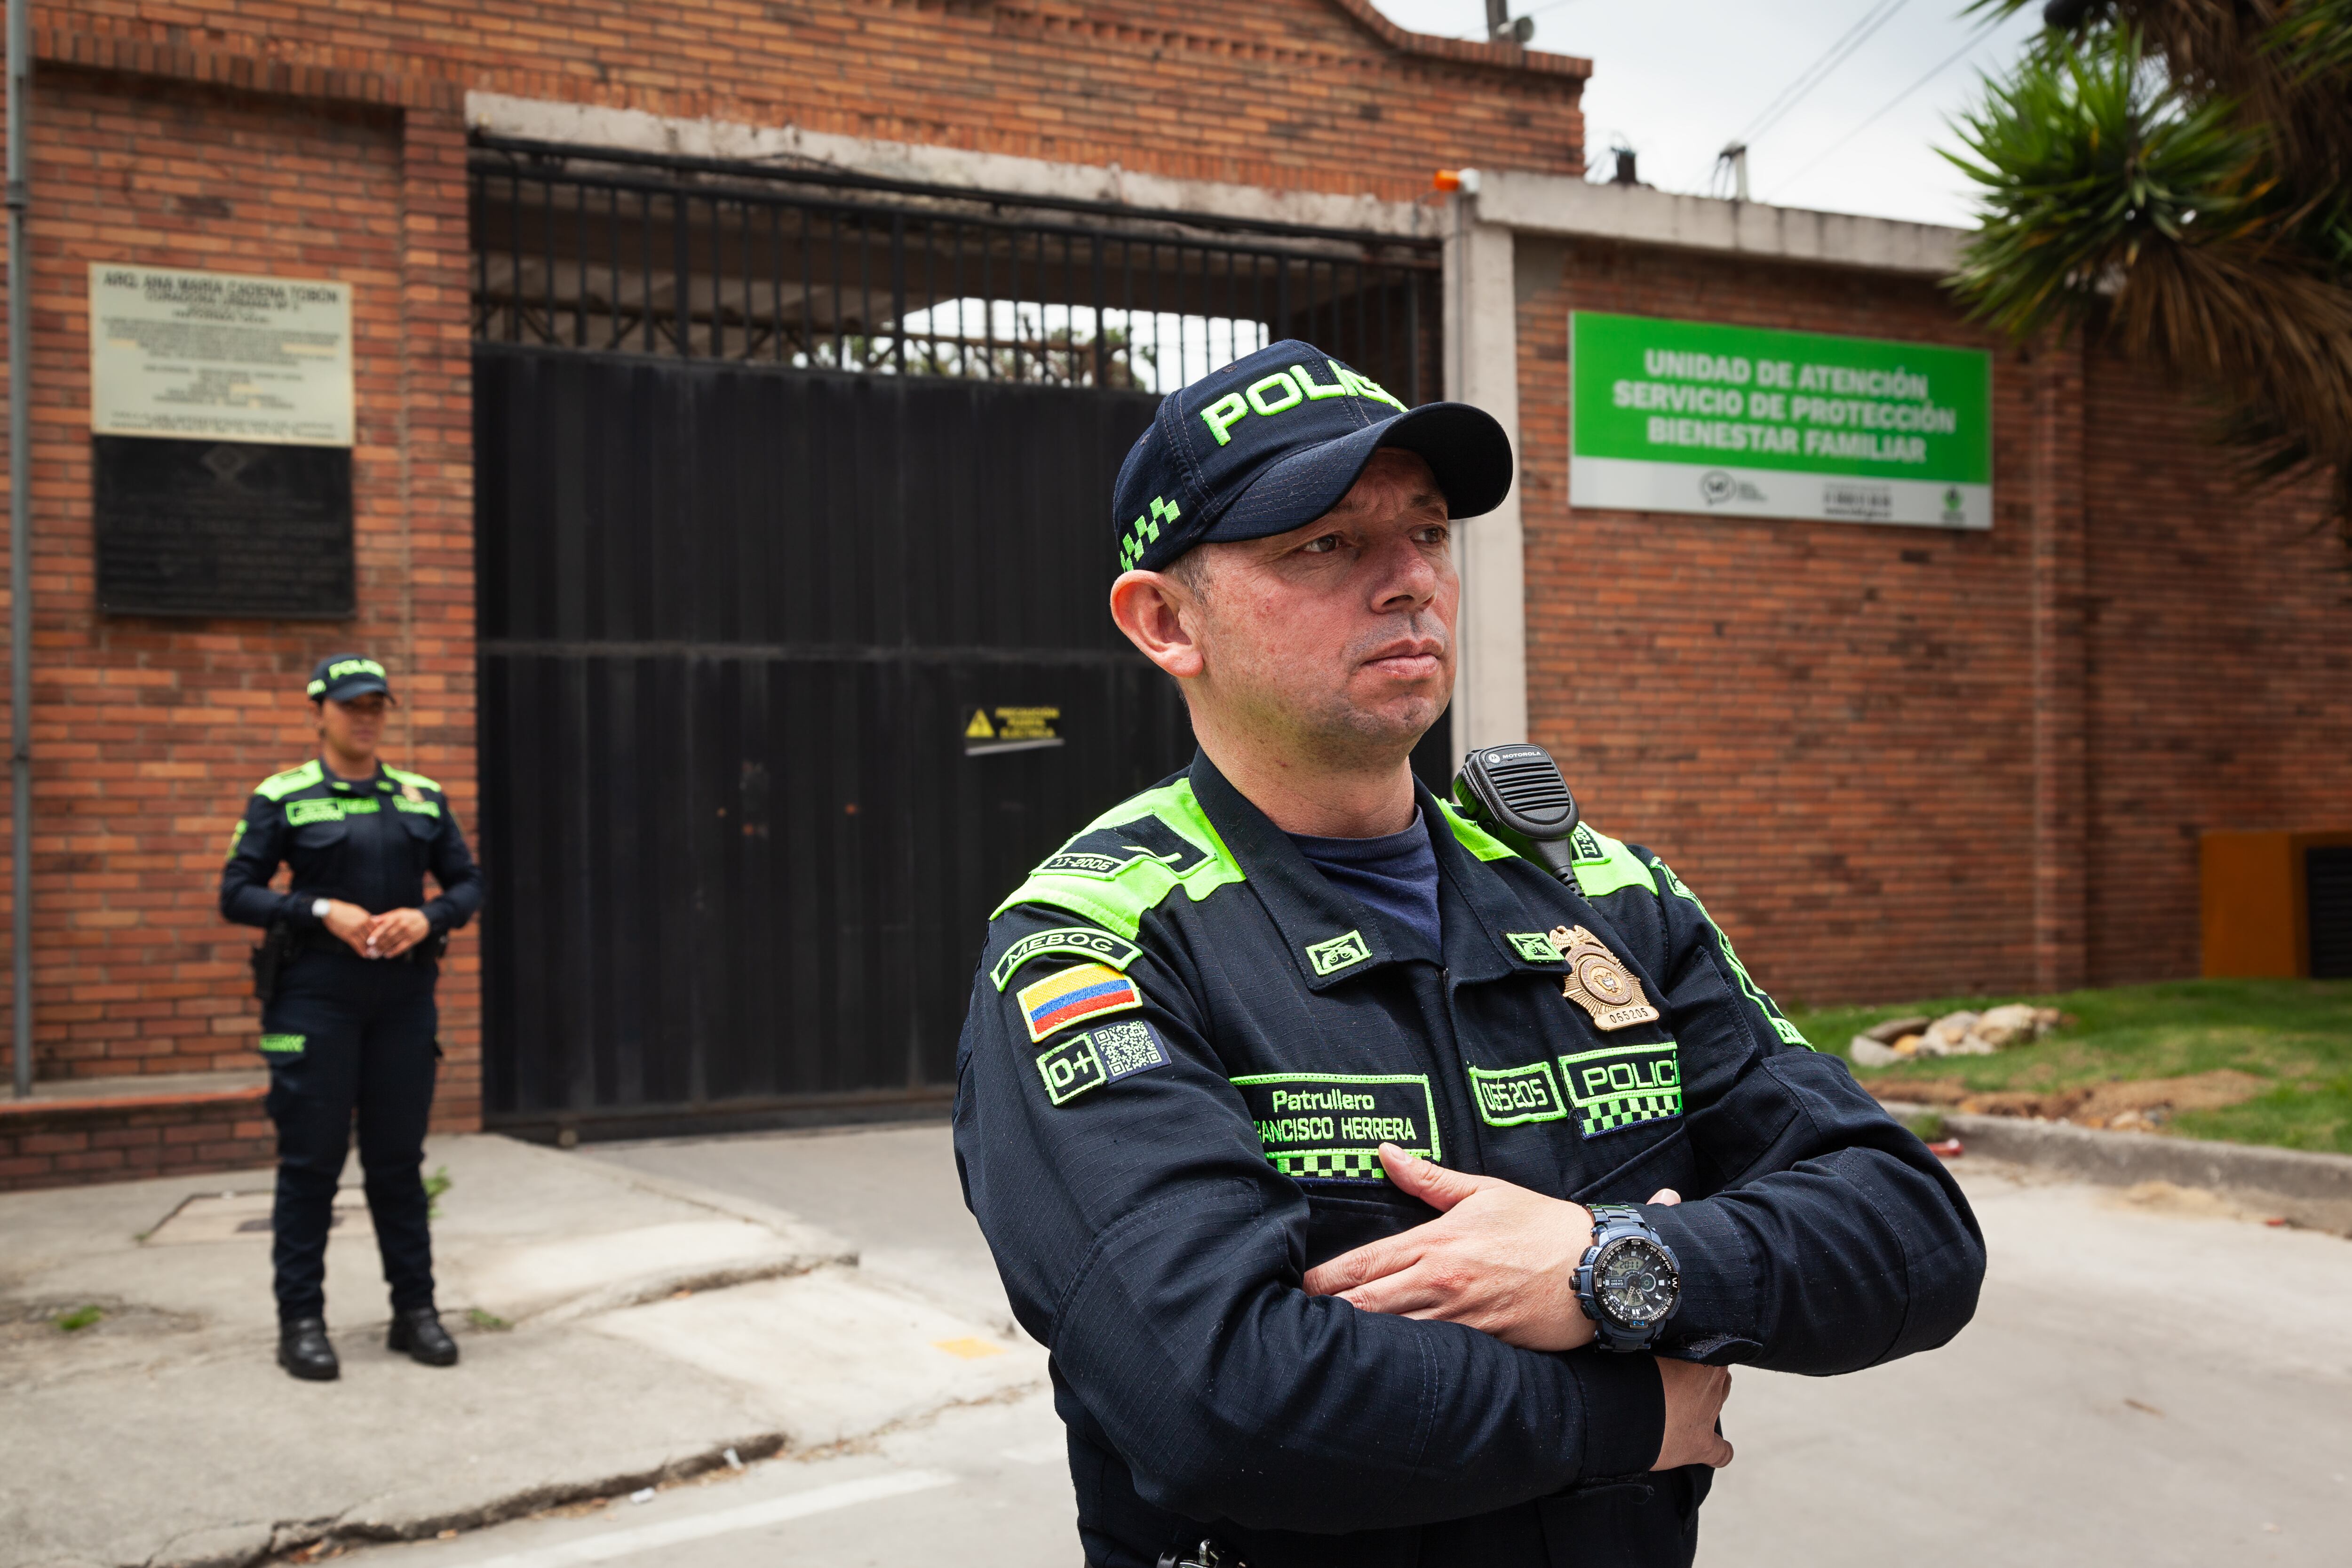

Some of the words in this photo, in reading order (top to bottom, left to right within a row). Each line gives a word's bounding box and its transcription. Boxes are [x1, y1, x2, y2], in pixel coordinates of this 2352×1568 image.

[1645, 349, 1751, 385] UNIDAD
[1757, 360, 1793, 389] DE
[1798, 365, 1928, 401] ATENCIÓN
[1613, 379, 1743, 417] SERVICIO
[1749, 392, 1787, 421] DE
[1791, 396, 1956, 434] PROTECCIÓN
[1647, 417, 1799, 454] BIENESTAR
[1804, 430, 1927, 462] FAMILIAR
[1050, 857, 1113, 871] 11-2006
[1008, 933, 1113, 968] MEBOG
[1610, 1008, 1648, 1024] 065205
[1272, 1089, 1375, 1113] Patrullero
[1481, 1078, 1548, 1112] 065205
[1342, 1117, 1417, 1141] HERRERA
[1587, 1249, 1597, 1263] RESET
[1669, 1251, 1679, 1266] MODE
